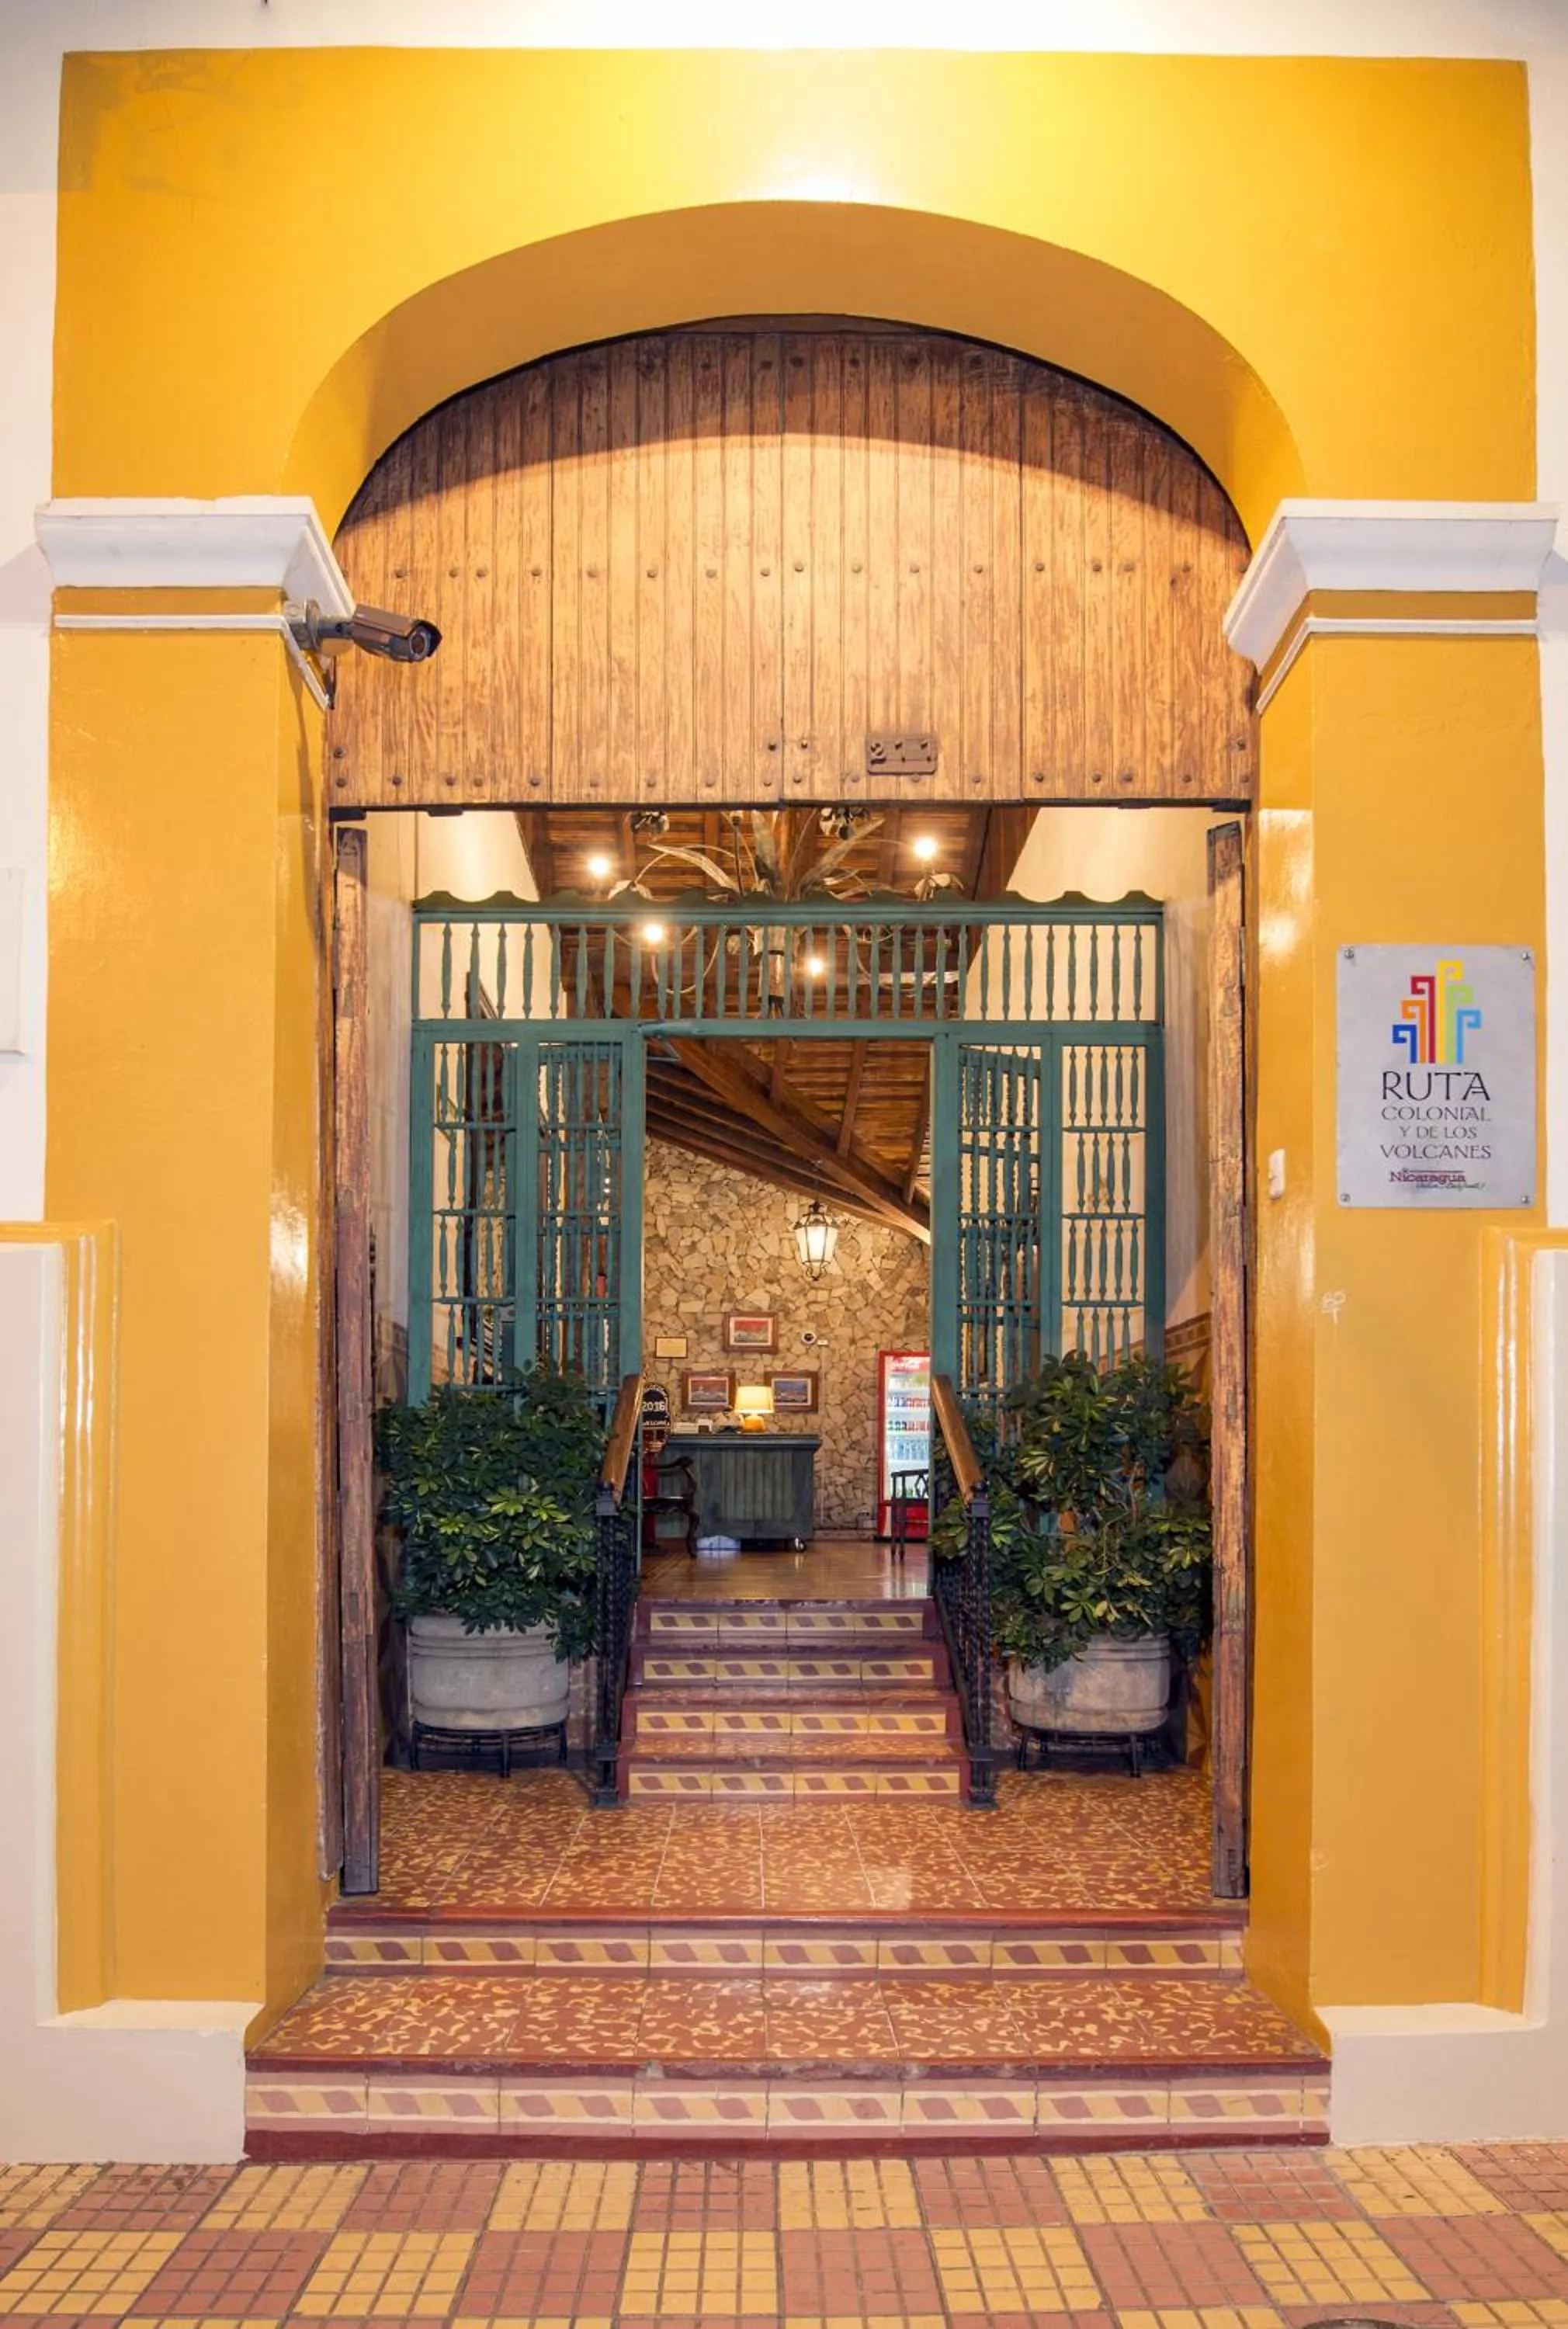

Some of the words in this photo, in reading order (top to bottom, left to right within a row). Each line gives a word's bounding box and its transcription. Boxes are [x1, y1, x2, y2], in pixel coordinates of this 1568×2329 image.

[1382, 1071, 1491, 1102] RUTA
[1381, 1105, 1491, 1122] COLONIAL
[1400, 1126, 1411, 1137] Y
[1416, 1126, 1437, 1139] DE
[1445, 1126, 1478, 1140] LOS
[1380, 1144, 1491, 1160] VOLCANES
[1389, 1169, 1466, 1185] Nicaragua
